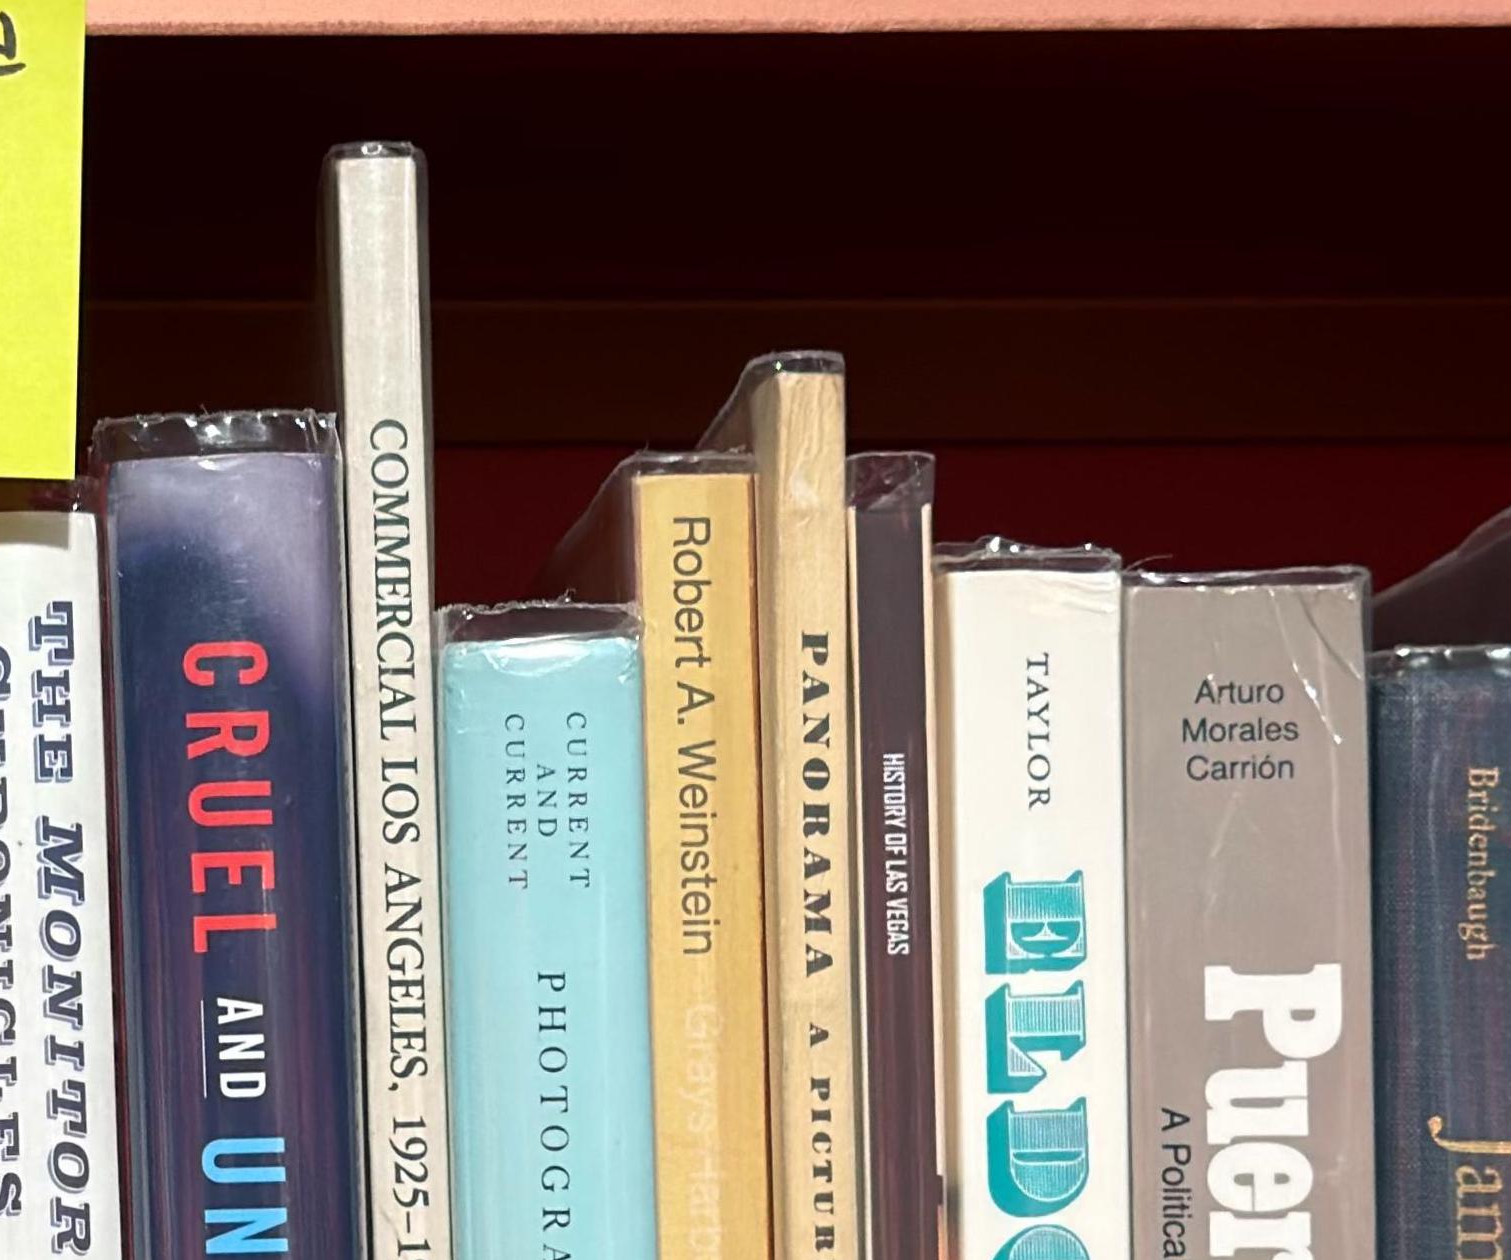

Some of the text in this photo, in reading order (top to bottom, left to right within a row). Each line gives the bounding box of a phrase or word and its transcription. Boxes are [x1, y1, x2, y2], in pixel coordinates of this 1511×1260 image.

[369, 417, 429, 1092] COMMERCIAL LOS ANGELES,
[672, 516, 721, 956] Robert A. Weinstein
[1026, 652, 1052, 812] TAYLOR
[1181, 717, 1300, 744] Morales
[1185, 754, 1295, 782] Carrión
[1194, 679, 1285, 705] Arturo
[182, 639, 278, 955] CRUEL
[800, 630, 834, 979] PANORAMA
[882, 752, 910, 957] HISTORY OF LAS VEGAS
[1456, 765, 1501, 961] Bridenbaugh
[28, 600, 92, 1257] THE MONITOR
[216, 996, 268, 1100] AND
[808, 1022, 830, 1048] A
[1159, 1105, 1192, 1133] A
